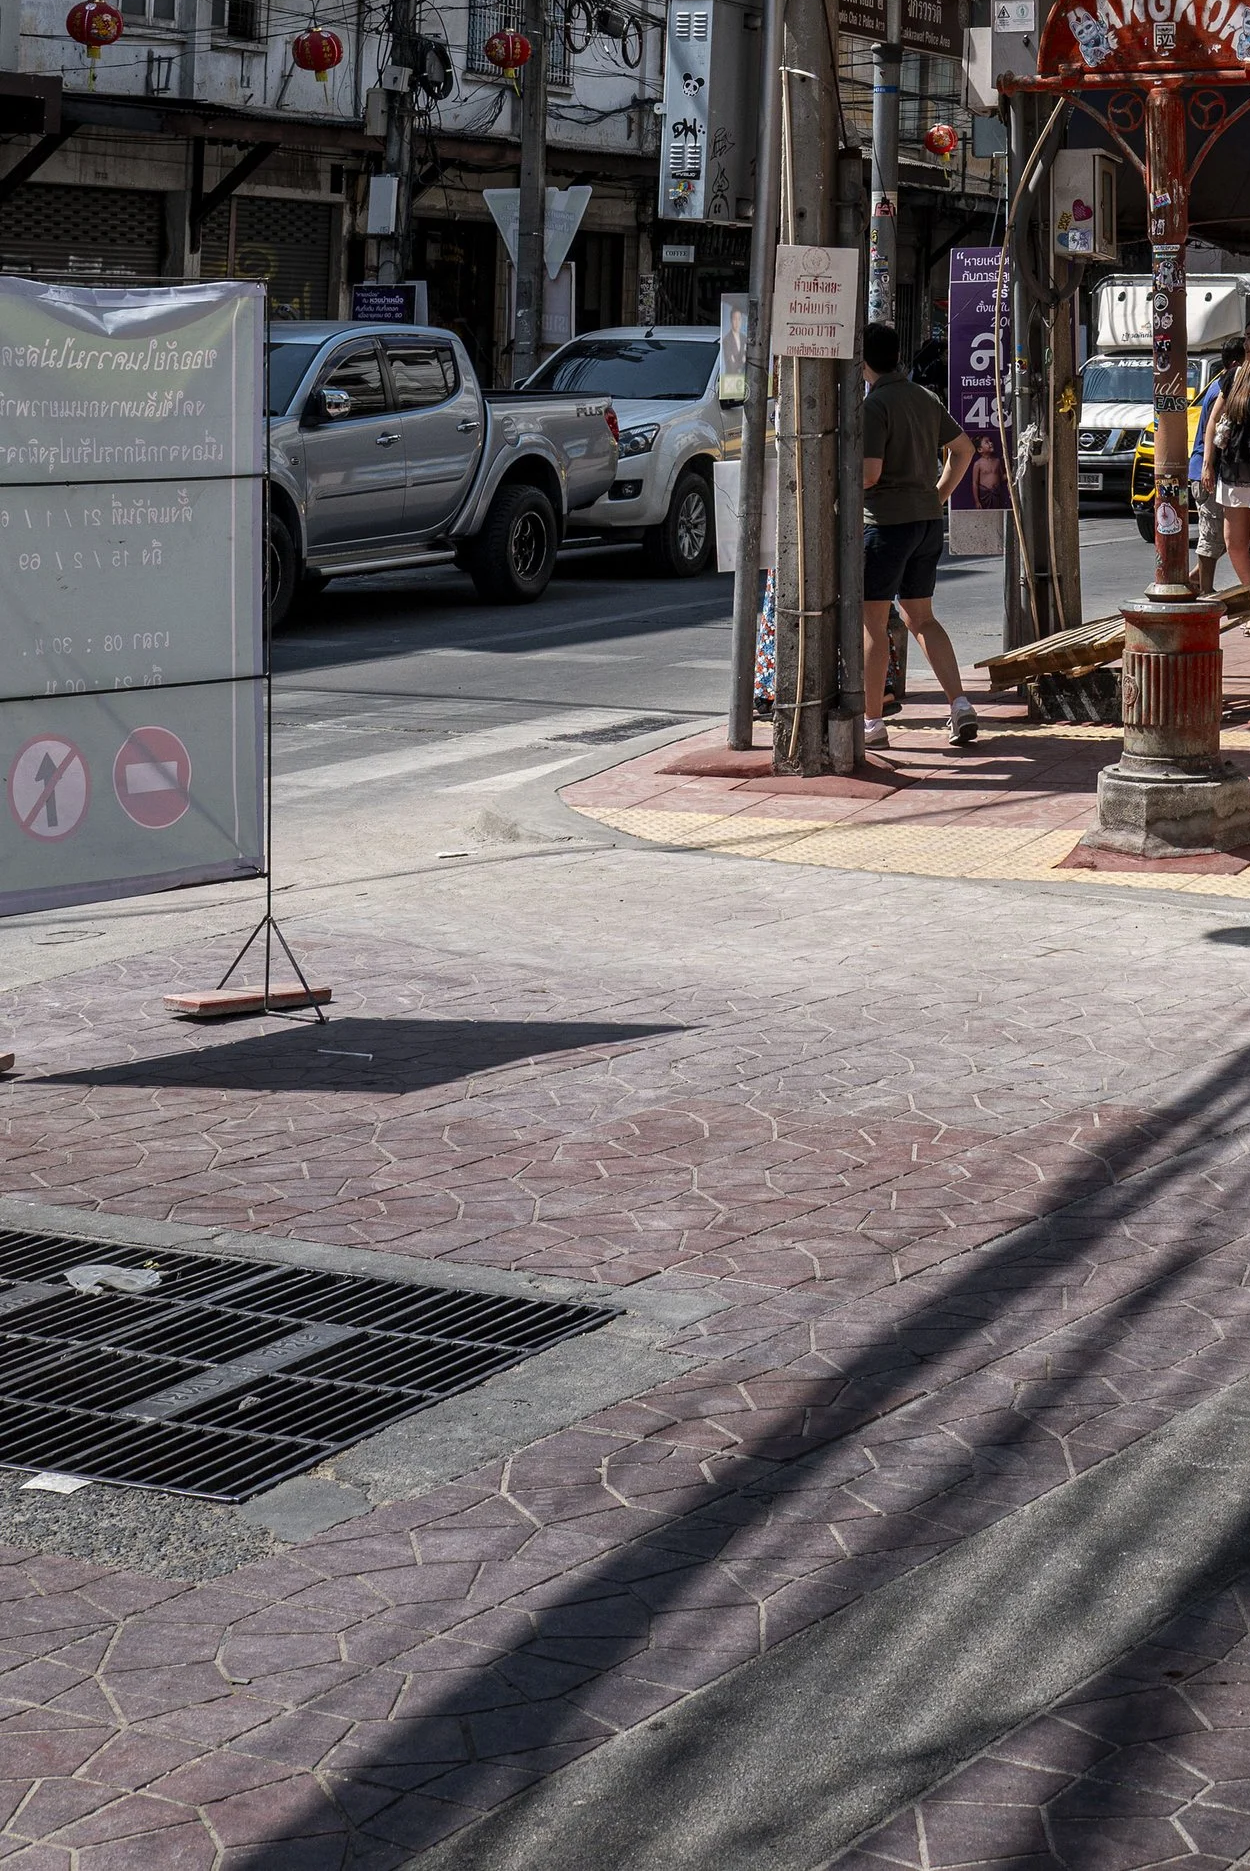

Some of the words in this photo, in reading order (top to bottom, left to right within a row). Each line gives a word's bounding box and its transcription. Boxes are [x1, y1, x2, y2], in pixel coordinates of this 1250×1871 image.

[863, 15, 874, 29] Police
[876, 19, 885, 31] Area
[925, 31, 938, 46] Police
[940, 35, 950, 48] Area
[789, 327, 814, 336] 2000
[817, 326, 836, 338] บาท
